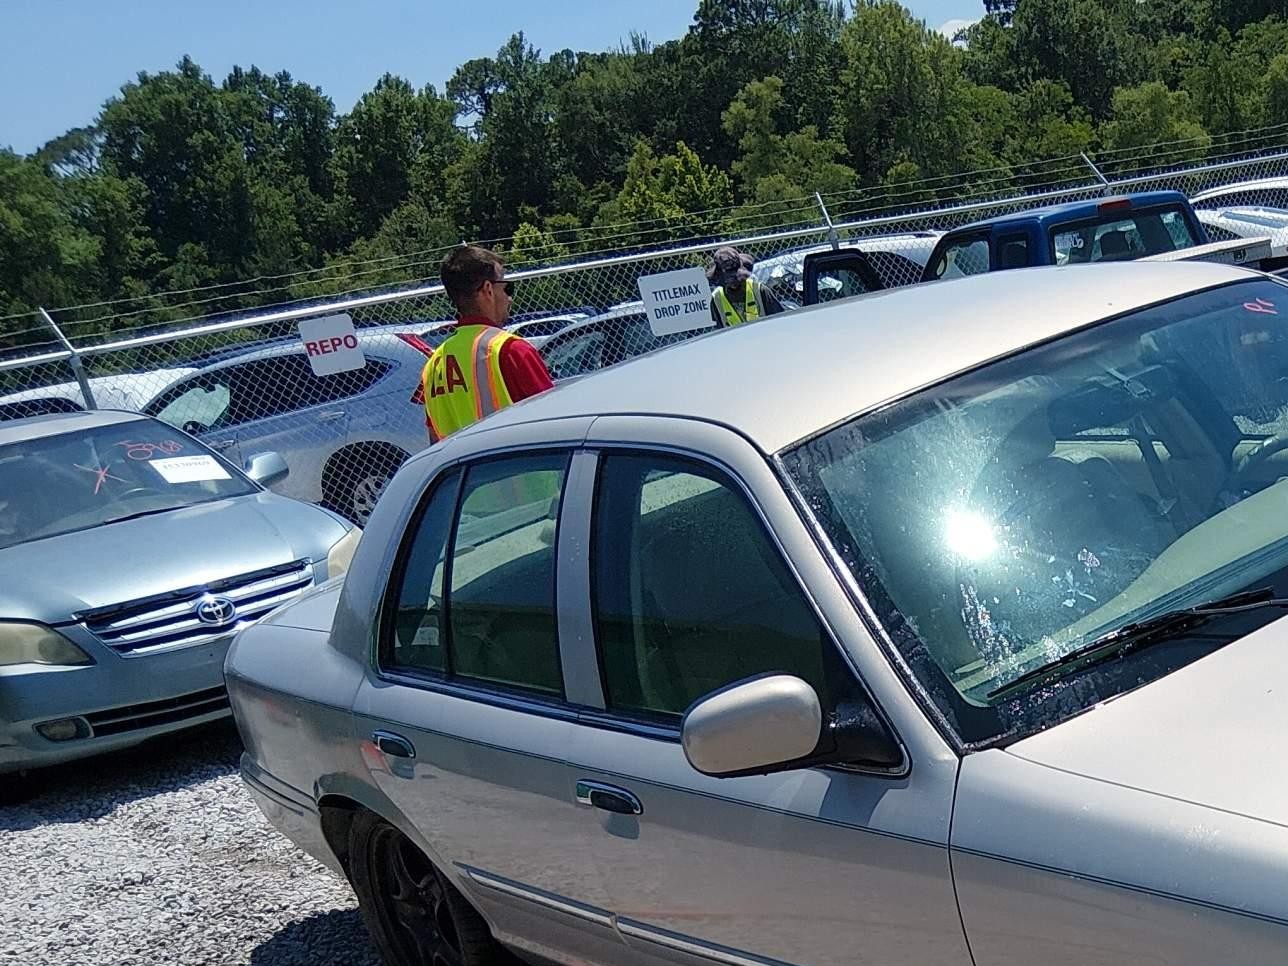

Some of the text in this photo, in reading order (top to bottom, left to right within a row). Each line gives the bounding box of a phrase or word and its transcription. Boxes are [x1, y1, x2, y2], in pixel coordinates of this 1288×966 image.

[652, 284, 701, 301] TITLEMAX
[654, 300, 709, 319] DROP ZONE
[305, 334, 358, 357] REPO
